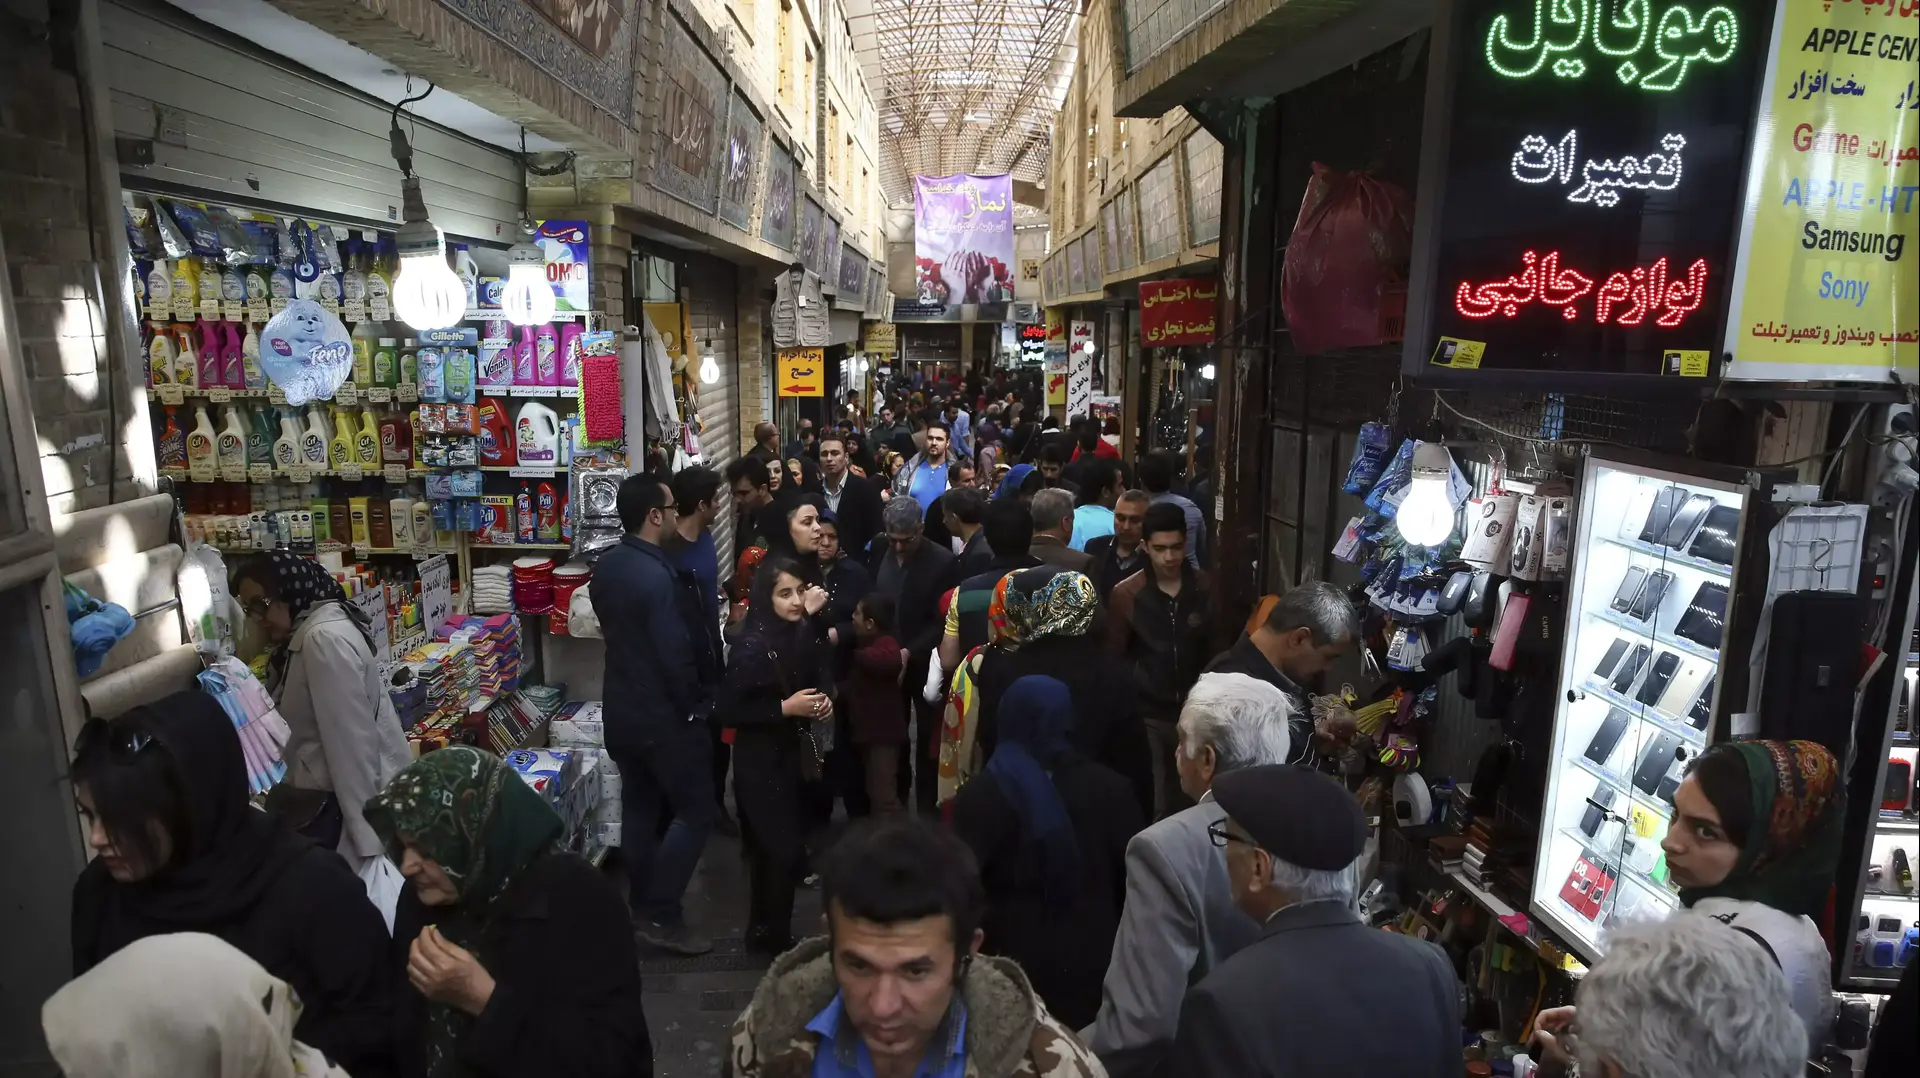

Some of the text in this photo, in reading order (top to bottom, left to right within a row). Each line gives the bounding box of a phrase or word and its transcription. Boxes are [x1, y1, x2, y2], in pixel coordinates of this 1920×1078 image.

[1486, 0, 1739, 90] موبایل
[1801, 27, 1919, 62] APPLE CEN
[1787, 69, 1866, 100] سخت افزار
[1511, 129, 1687, 208] تعمیرات
[963, 192, 1006, 219] نماز
[1802, 220, 1906, 262] Samsung
[546, 262, 585, 282] OMO
[1143, 286, 1191, 308] اجناس
[1455, 250, 1708, 326] لوازم جانبی
[1818, 271, 1869, 308] Sony
[430, 331, 465, 341] Gillette
[1147, 316, 1216, 342] قیمت تجاری
[1752, 321, 1788, 343] تبلت
[1786, 325, 1822, 344] تعمیر
[1832, 325, 1876, 347] ویندوز
[1879, 328, 1919, 347] نصب
[309, 344, 347, 366] Feno
[780, 350, 800, 362] احرام
[484, 355, 509, 378] Vanish
[791, 367, 814, 379] حج
[192, 438, 202, 447] Cif
[222, 437, 233, 447] Cif
[306, 436, 317, 446] Cif
[361, 436, 371, 446] Cif
[480, 437, 496, 447] OMO
[519, 501, 529, 511] Pril
[539, 494, 551, 505] Pril
[480, 510, 494, 524] Pril
[1529, 551, 1538, 573] SONY
[1574, 861, 1588, 877] 08
